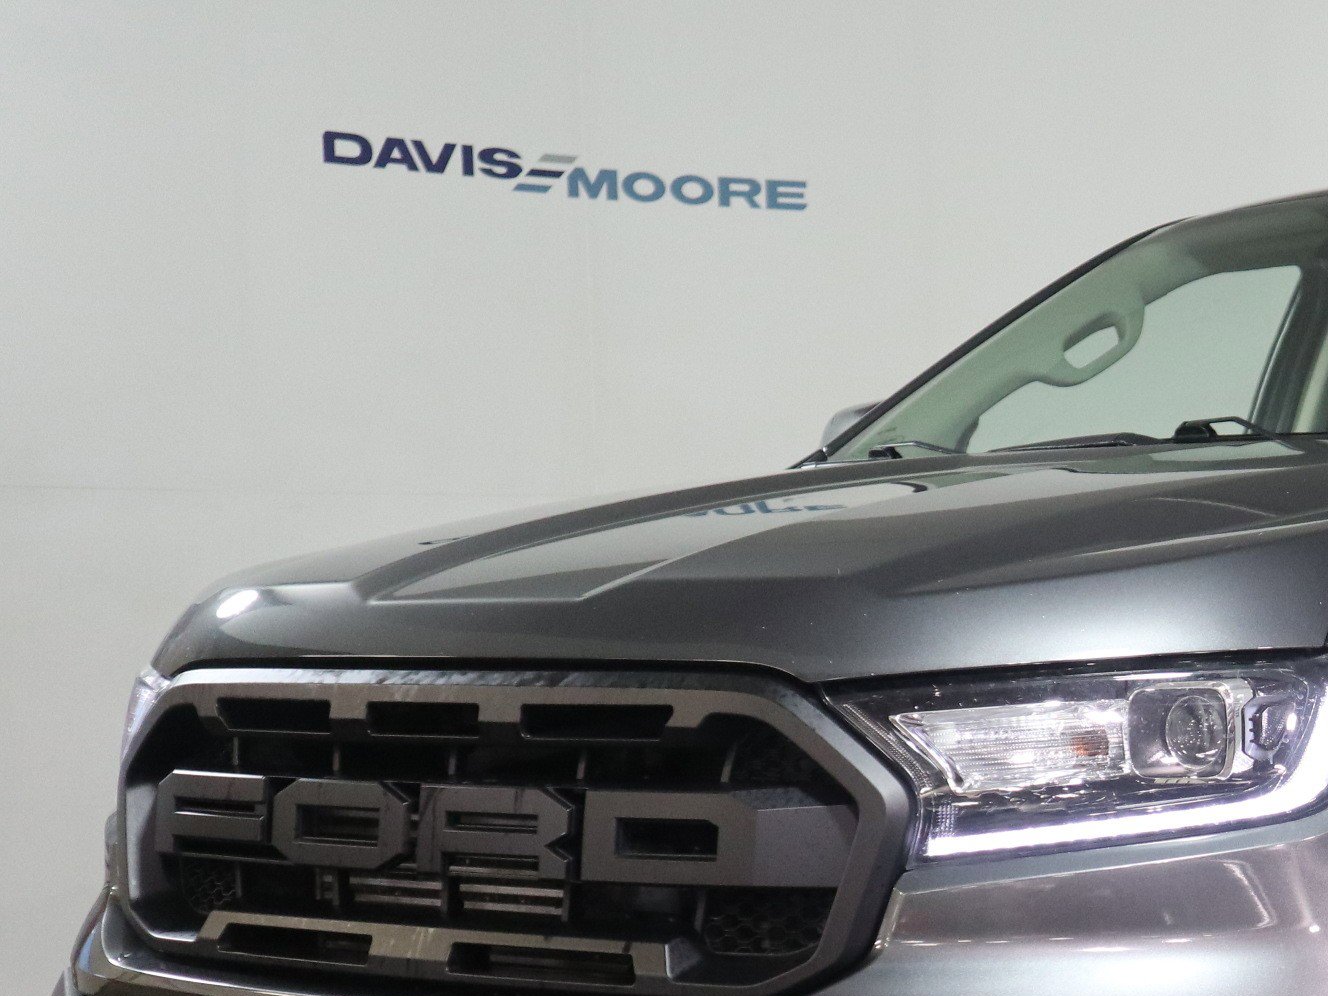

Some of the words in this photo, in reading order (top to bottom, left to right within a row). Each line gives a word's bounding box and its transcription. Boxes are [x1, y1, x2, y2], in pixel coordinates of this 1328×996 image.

[322, 130, 523, 180] DAVIS
[566, 166, 808, 211] MOORE
[155, 768, 758, 887] FORD
